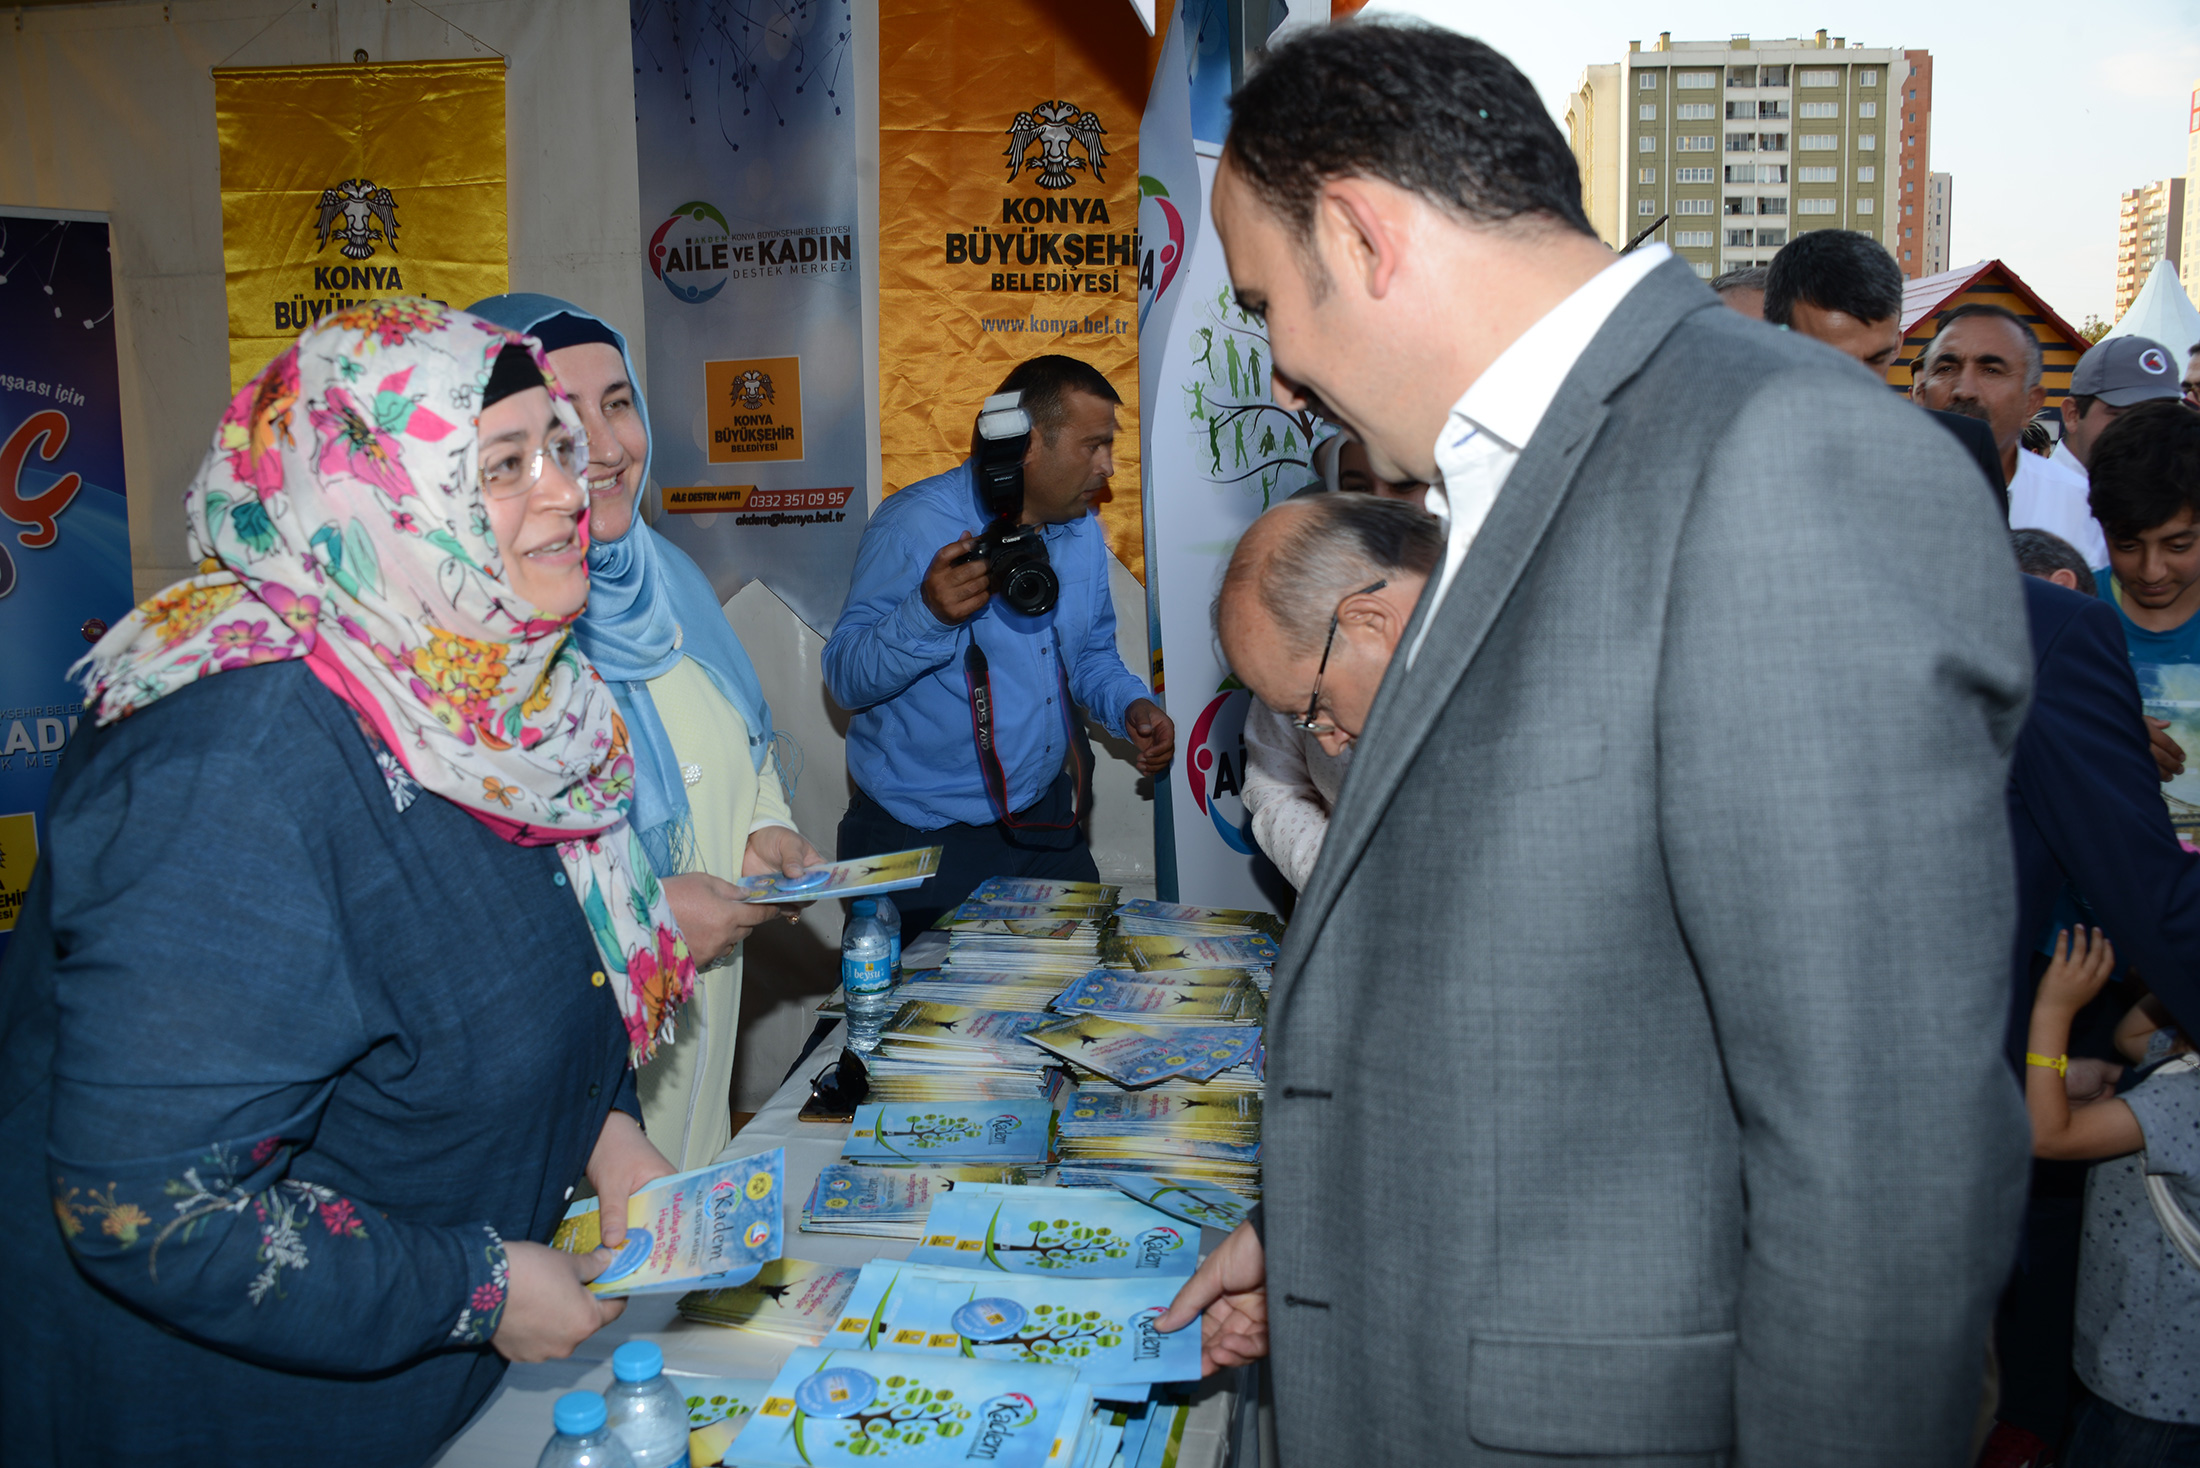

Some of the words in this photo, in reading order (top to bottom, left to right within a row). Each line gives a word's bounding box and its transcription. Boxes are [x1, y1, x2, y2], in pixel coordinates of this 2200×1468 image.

[1002, 198, 1111, 224] KONYA
[695, 235, 728, 244] AKDEM
[731, 233, 756, 242] KONYA
[665, 238, 729, 273] AİLE
[732, 246, 754, 262] VE
[758, 235, 851, 266] KADIN
[314, 266, 403, 290] KONYA
[733, 266, 783, 279] DESTEK
[991, 268, 1119, 293] BELEDİYESİ
[981, 314, 1129, 337] www.konya.bel.tr
[55, 383, 85, 407] için
[734, 414, 773, 426] KONYA
[714, 425, 795, 443] BÜYÜKŞEHİR
[731, 442, 778, 453] BELEDİYESİ
[688, 492, 716, 502] DESTEK
[750, 495, 780, 508] 0332
[783, 493, 805, 507] 351
[808, 493, 825, 506] 09
[828, 492, 845, 505] 95
[735, 510, 846, 528] akdem@konya.bel.tr
[974, 687, 987, 724] EOS
[978, 727, 990, 751] 70D
[854, 968, 881, 982] beysu
[988, 1118, 1013, 1145] Kadem
[709, 1191, 735, 1262] Kadem
[1135, 1234, 1171, 1269] Kadem
[966, 1402, 1025, 1461] Kadem
